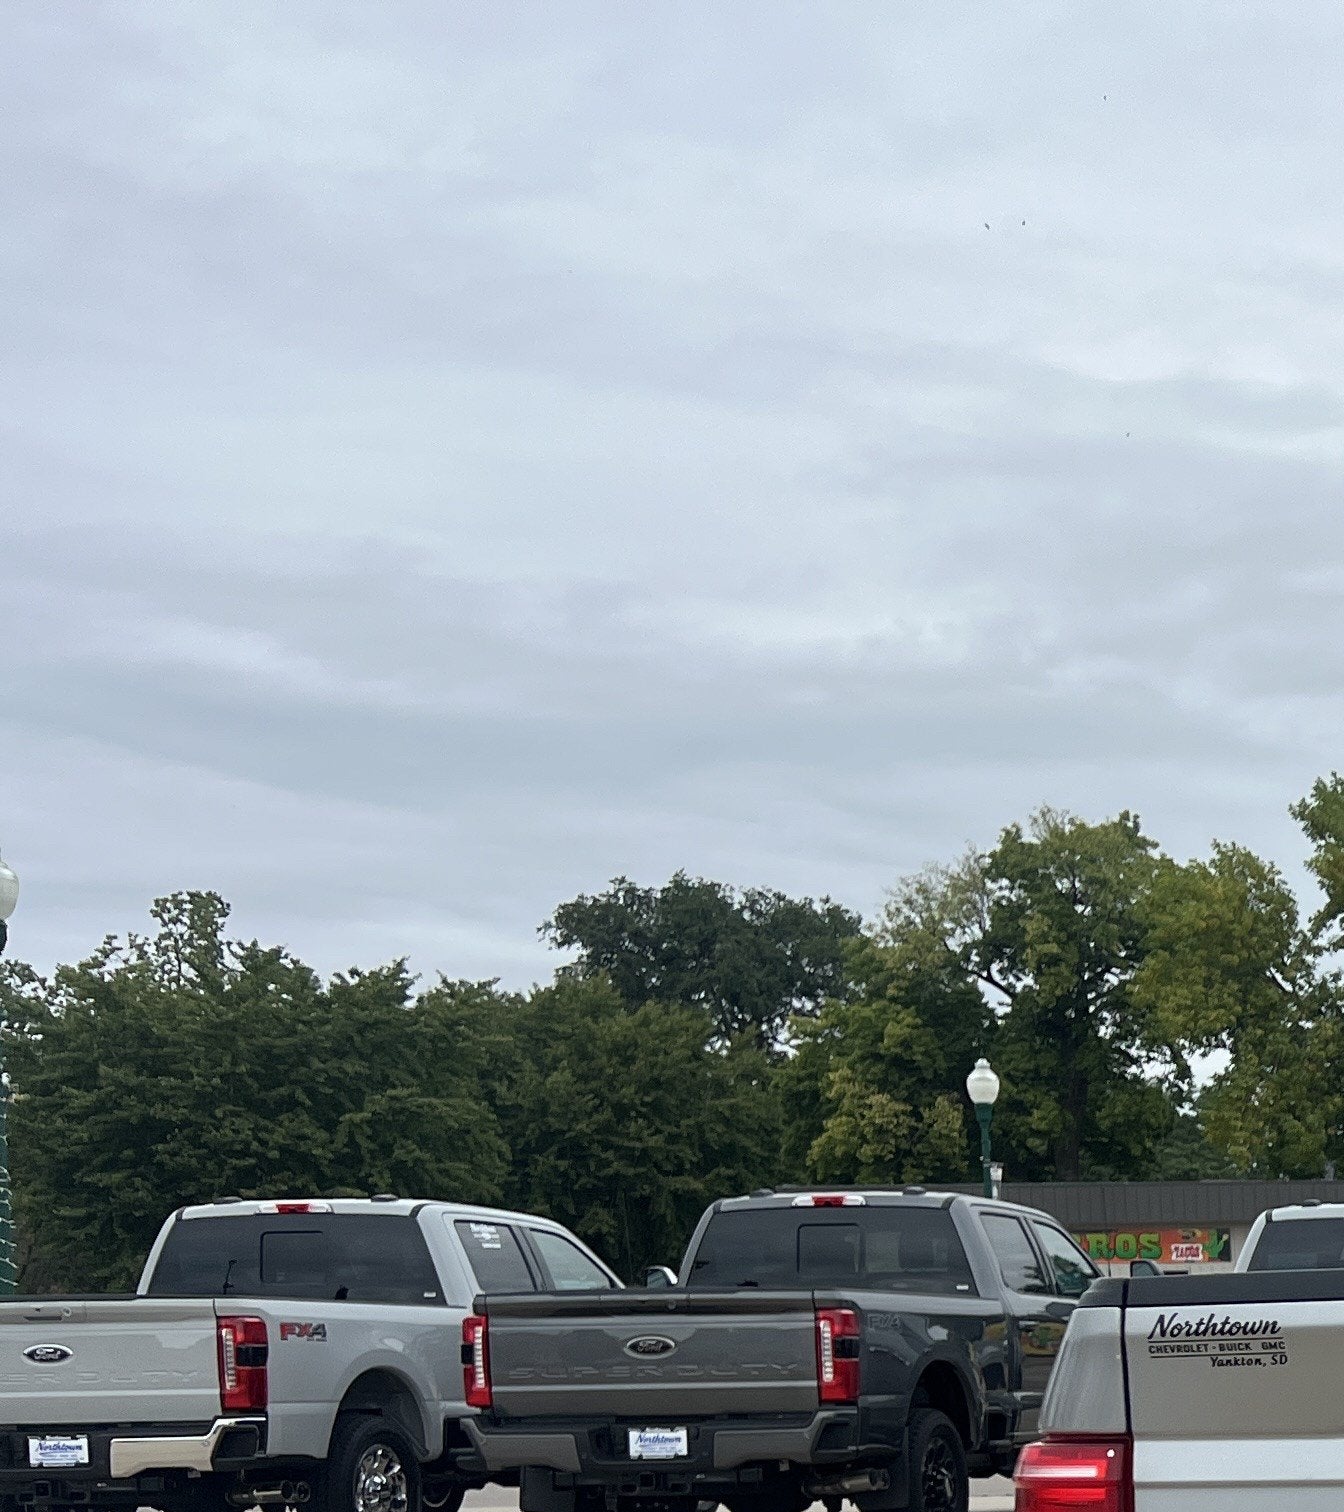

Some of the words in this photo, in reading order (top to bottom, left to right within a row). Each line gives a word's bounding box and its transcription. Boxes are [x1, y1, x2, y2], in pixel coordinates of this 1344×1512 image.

[1147, 1312, 1282, 1340] Northtown
[1149, 1343, 1209, 1354] CHEVROLET
[1219, 1342, 1252, 1352] BUICK
[1261, 1341, 1286, 1350] GMC
[1210, 1356, 1267, 1367] Yankton,
[1270, 1354, 1288, 1365] SD
